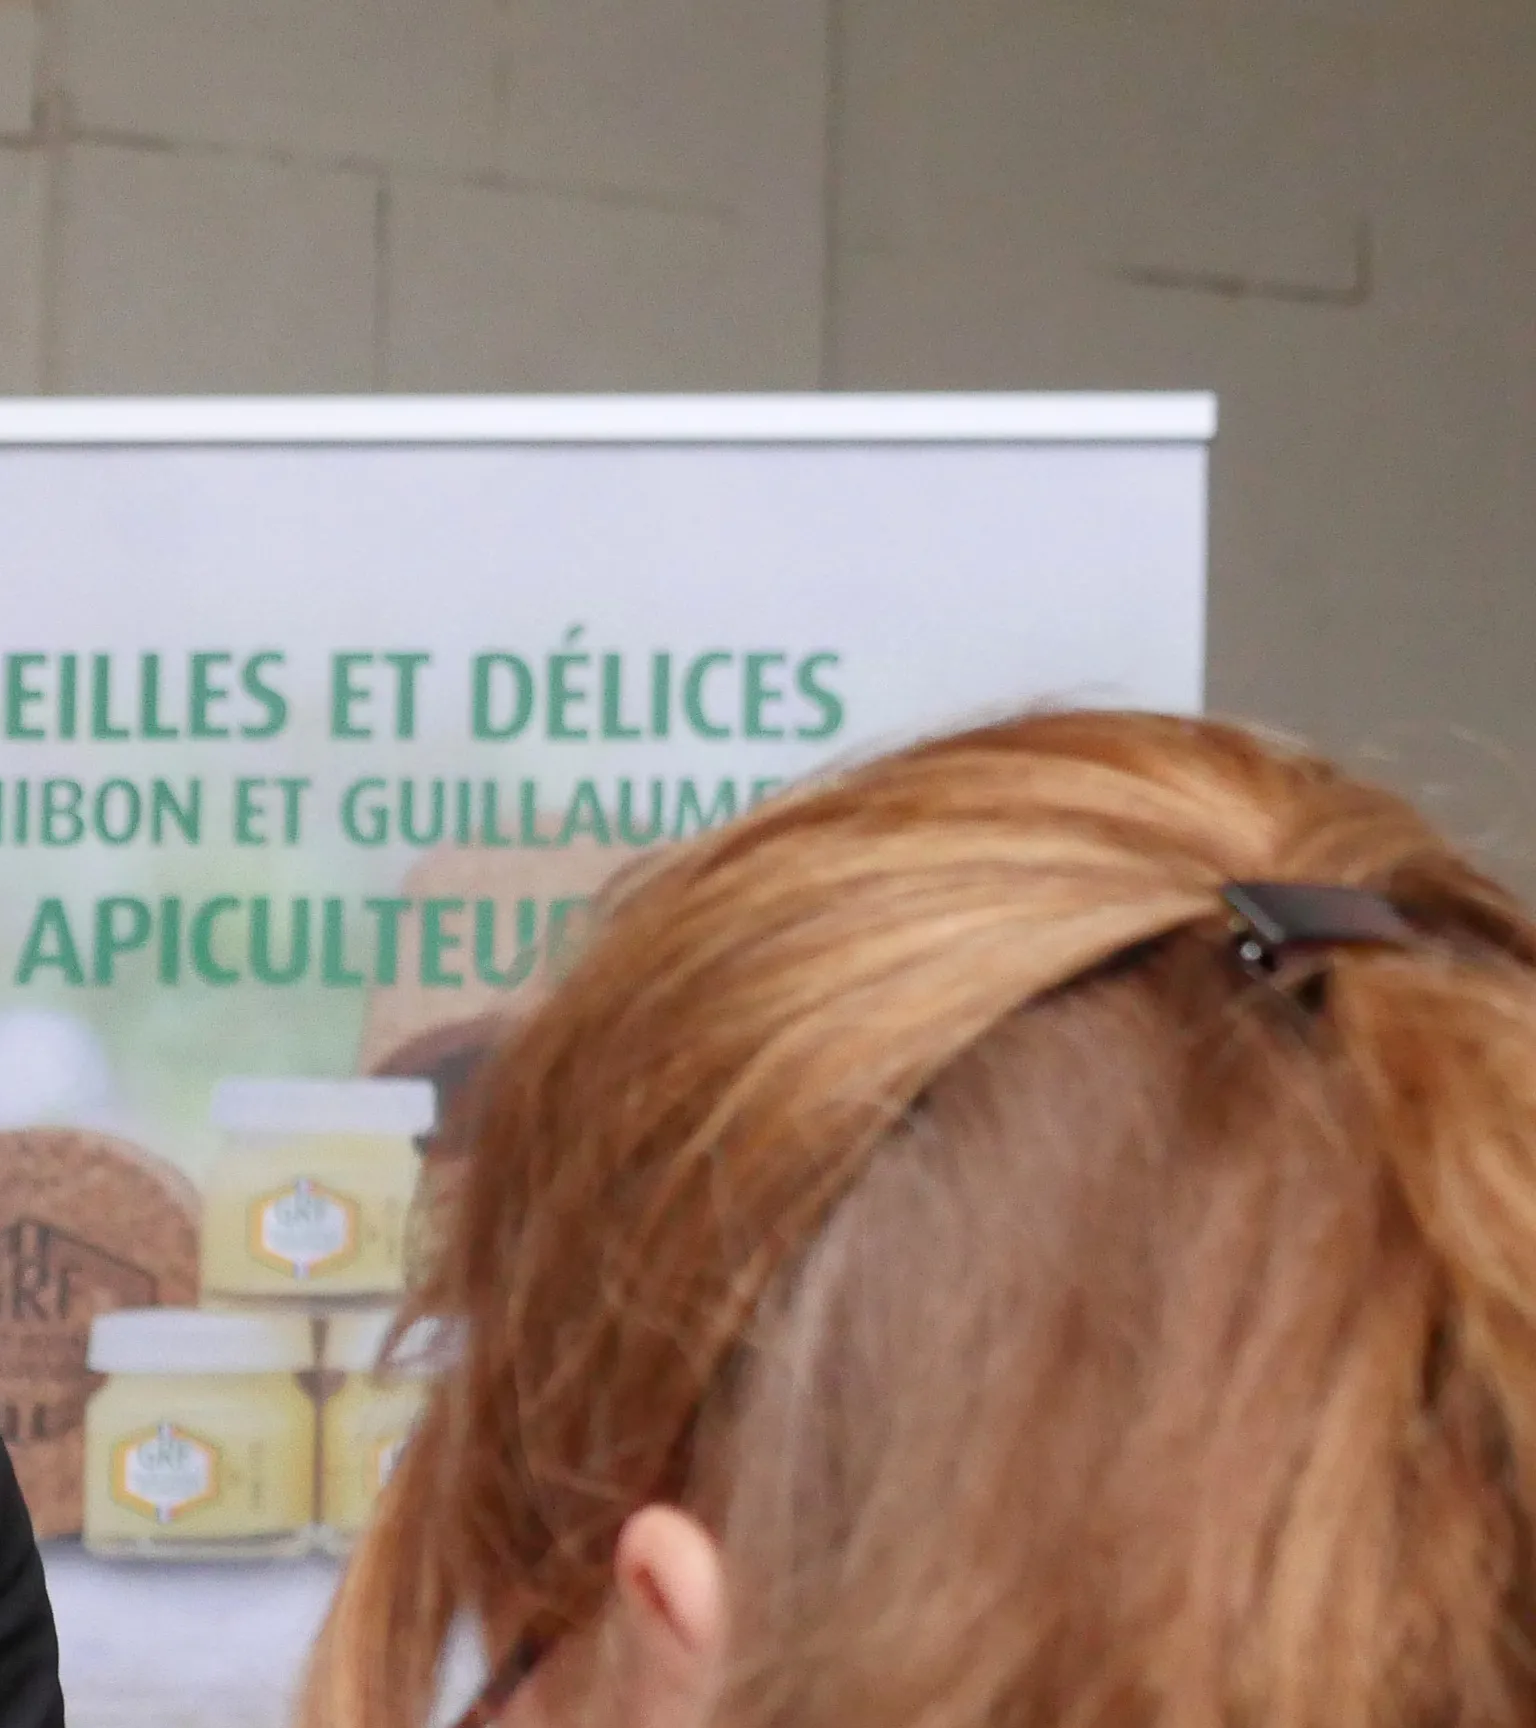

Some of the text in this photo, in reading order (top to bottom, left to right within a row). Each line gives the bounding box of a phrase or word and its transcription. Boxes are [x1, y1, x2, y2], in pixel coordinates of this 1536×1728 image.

[329, 653, 432, 741] ET
[469, 624, 845, 745] DÉLICES
[233, 776, 316, 850] ET
